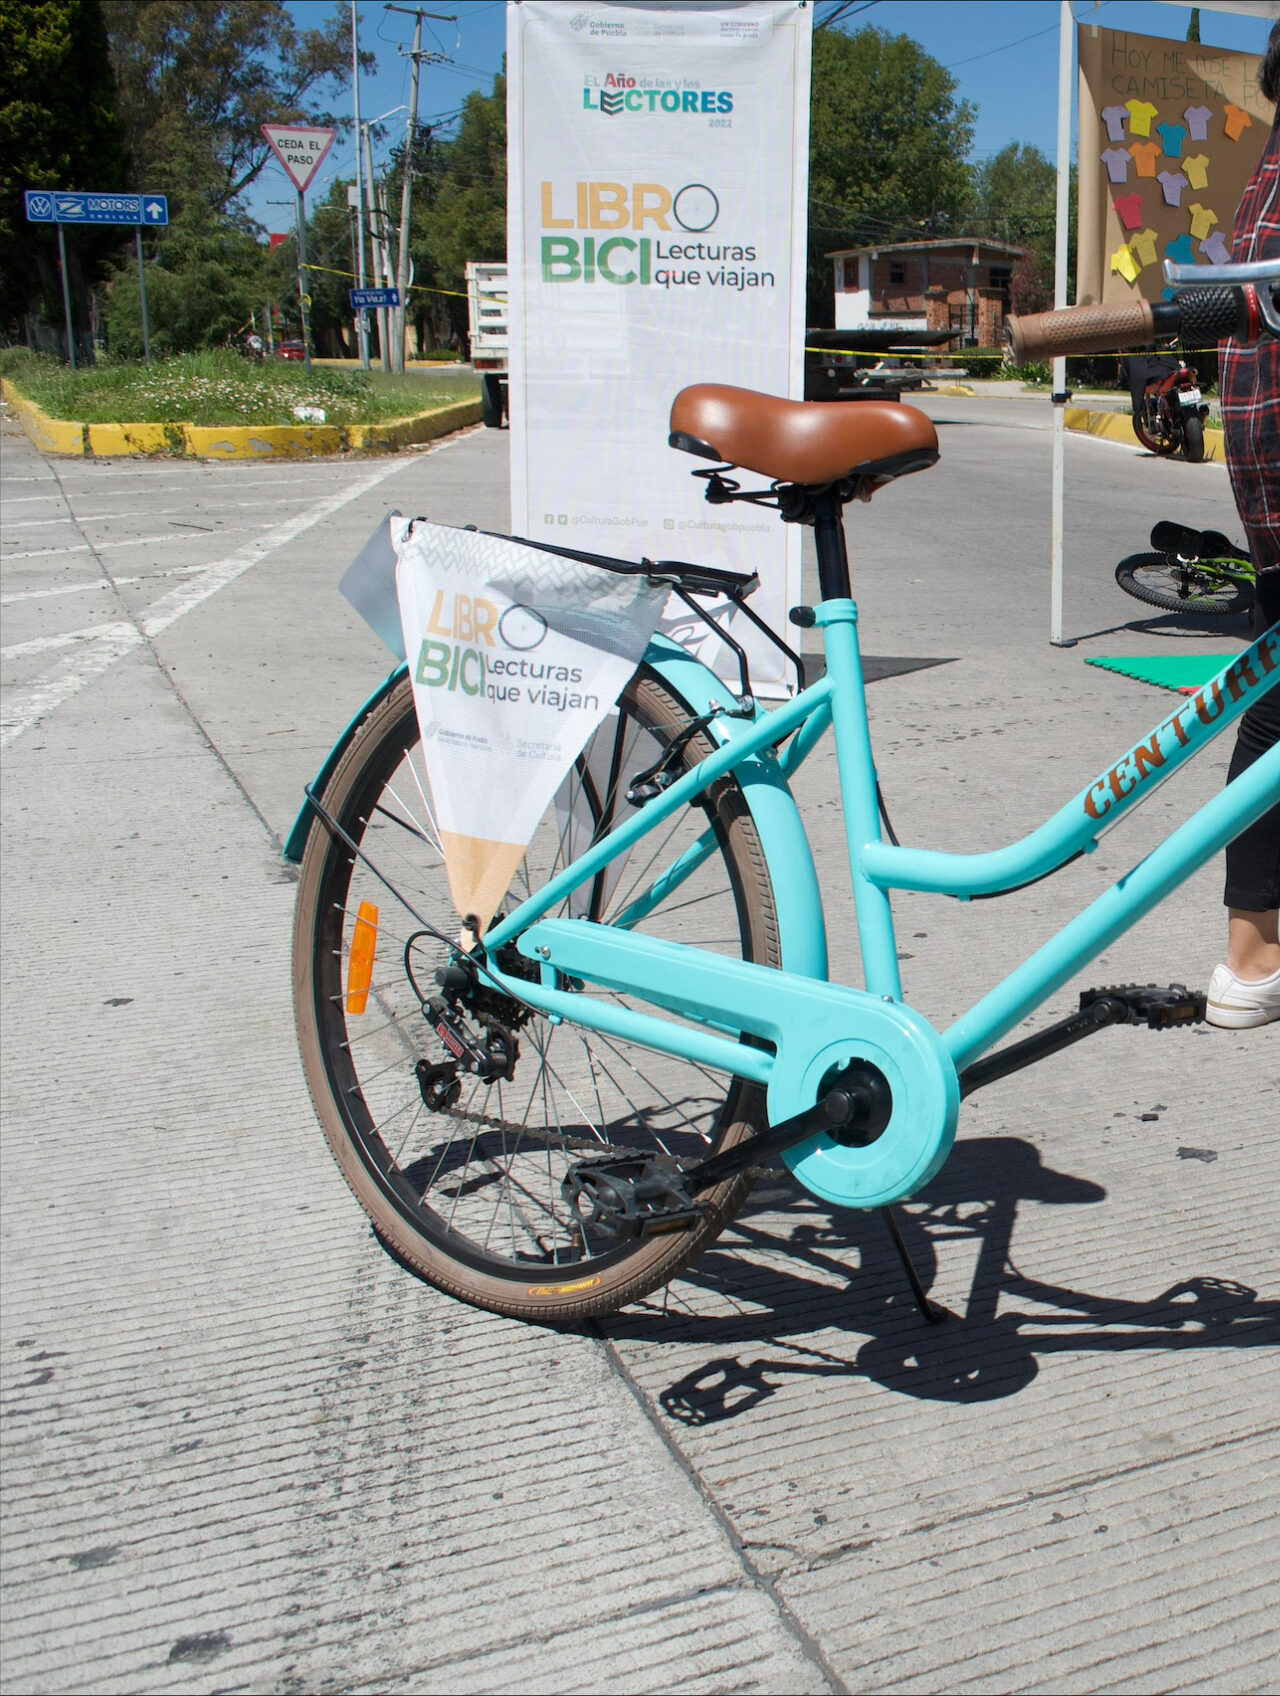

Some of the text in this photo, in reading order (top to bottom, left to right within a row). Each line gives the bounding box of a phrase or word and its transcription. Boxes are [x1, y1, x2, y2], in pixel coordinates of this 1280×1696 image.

[1111, 31, 1152, 72] HOY
[1163, 52, 1186, 75] ME
[604, 72, 637, 89] Año
[639, 77, 654, 89] de
[655, 77, 672, 88] las
[684, 77, 701, 88] los
[1111, 75, 1227, 102] CAMISETA
[708, 119, 733, 129] 2022
[277, 138, 321, 151] CEDA EL
[287, 154, 314, 165] PASO
[87, 198, 139, 212] MOTORS
[541, 181, 719, 232] LIBRO
[541, 236, 652, 285] BICI
[656, 240, 757, 261] Lecturas
[655, 266, 775, 291] que viajan
[426, 589, 549, 650] LIBRO
[415, 638, 487, 698] BICI
[486, 654, 583, 683] Lecturas
[486, 684, 599, 712] que viajan
